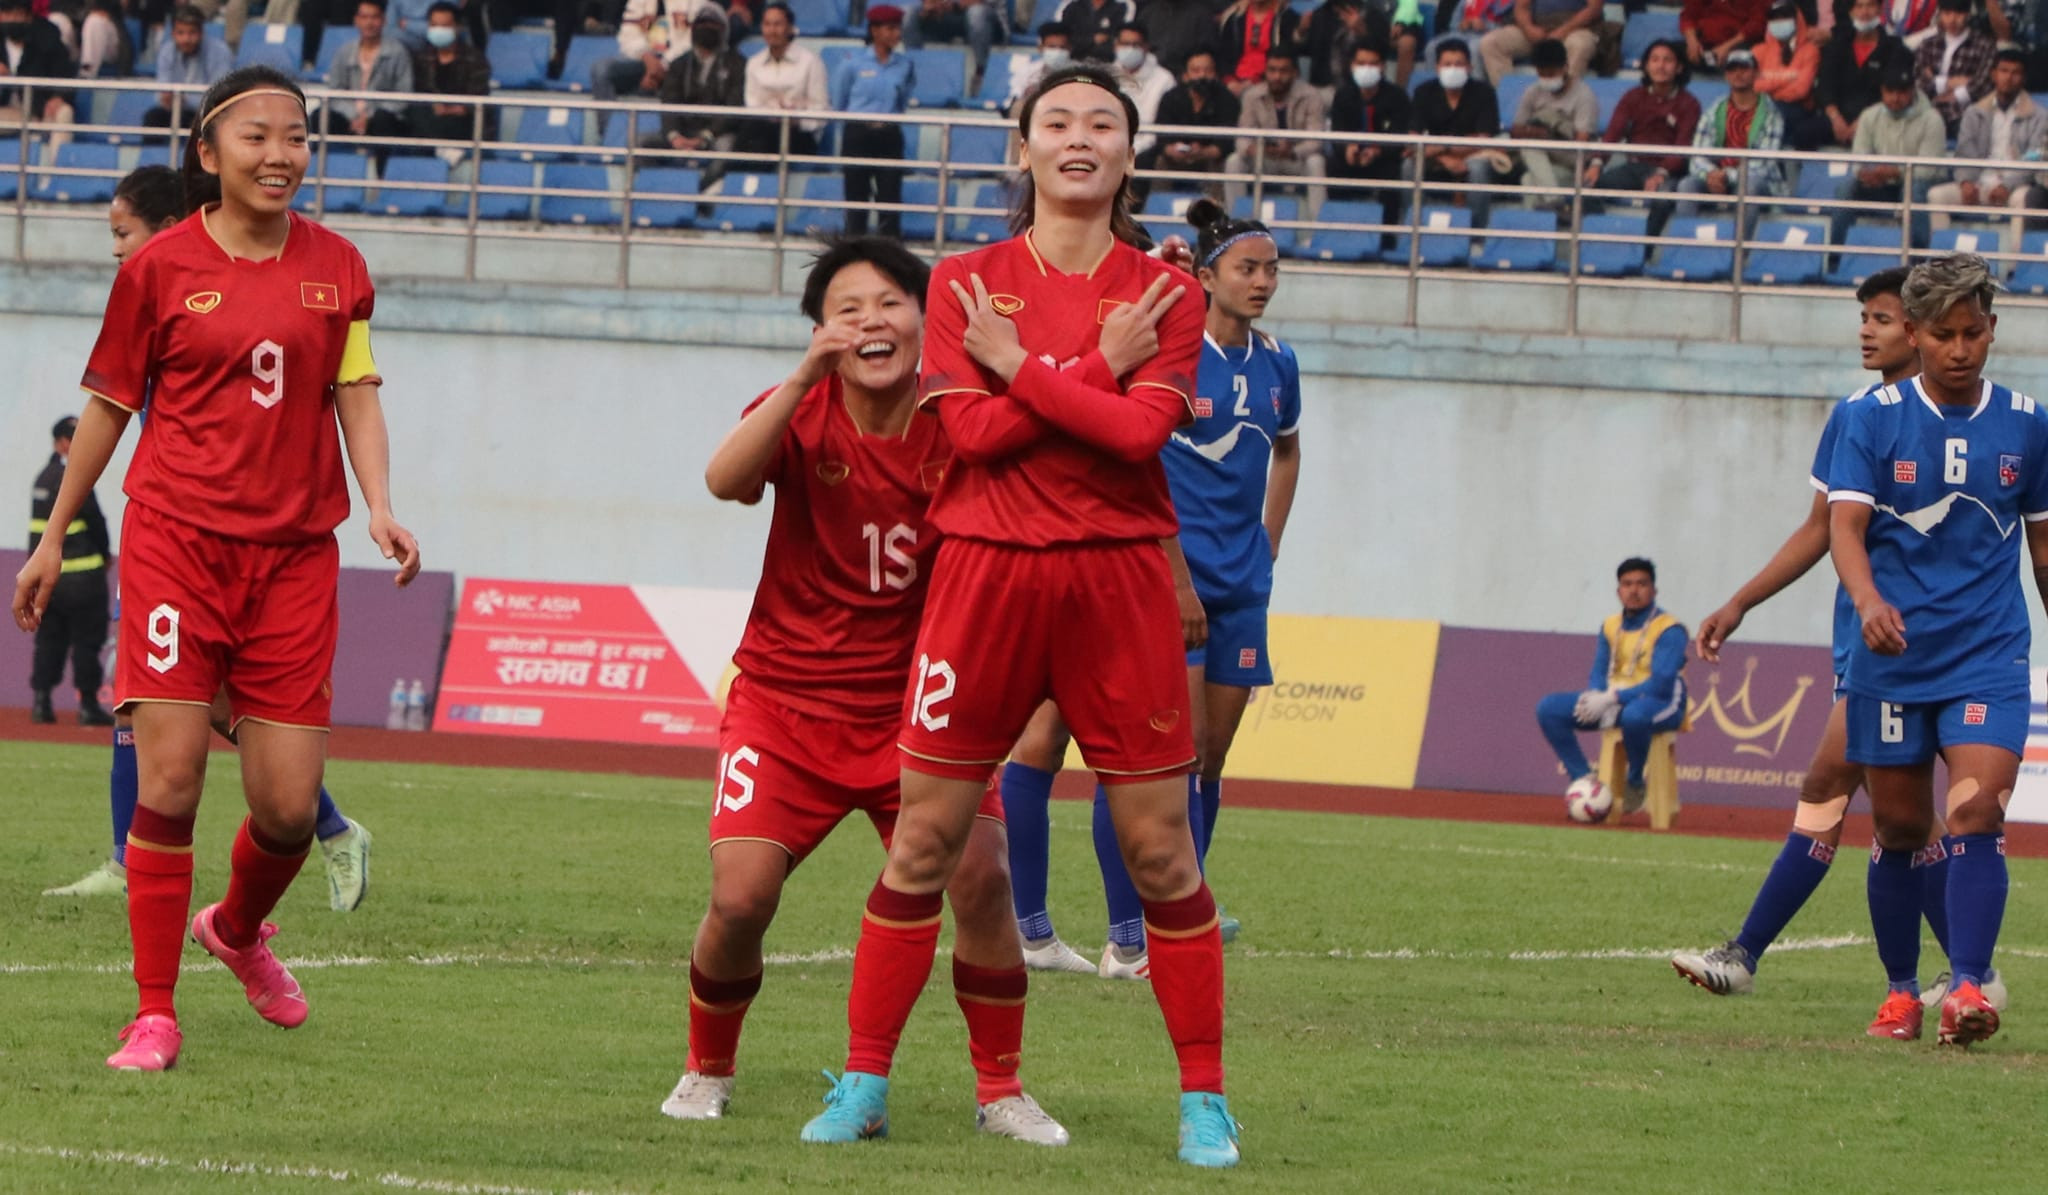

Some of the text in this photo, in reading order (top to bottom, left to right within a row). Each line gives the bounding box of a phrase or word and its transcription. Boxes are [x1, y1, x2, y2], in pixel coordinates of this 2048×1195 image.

[252, 339, 284, 410] 9
[1232, 374, 1251, 416] 2
[1943, 437, 1968, 485] 6
[862, 521, 918, 593] 15
[507, 594, 581, 613] NIC ASIA
[147, 603, 181, 674] 9
[496, 657, 593, 687] सम्भव
[911, 653, 957, 732] 12
[1273, 681, 1366, 702] COMING
[1268, 703, 1337, 722] SOON
[1881, 701, 1904, 743] 6
[713, 745, 760, 817] 15
[1705, 767, 1782, 786] RESEARCH
